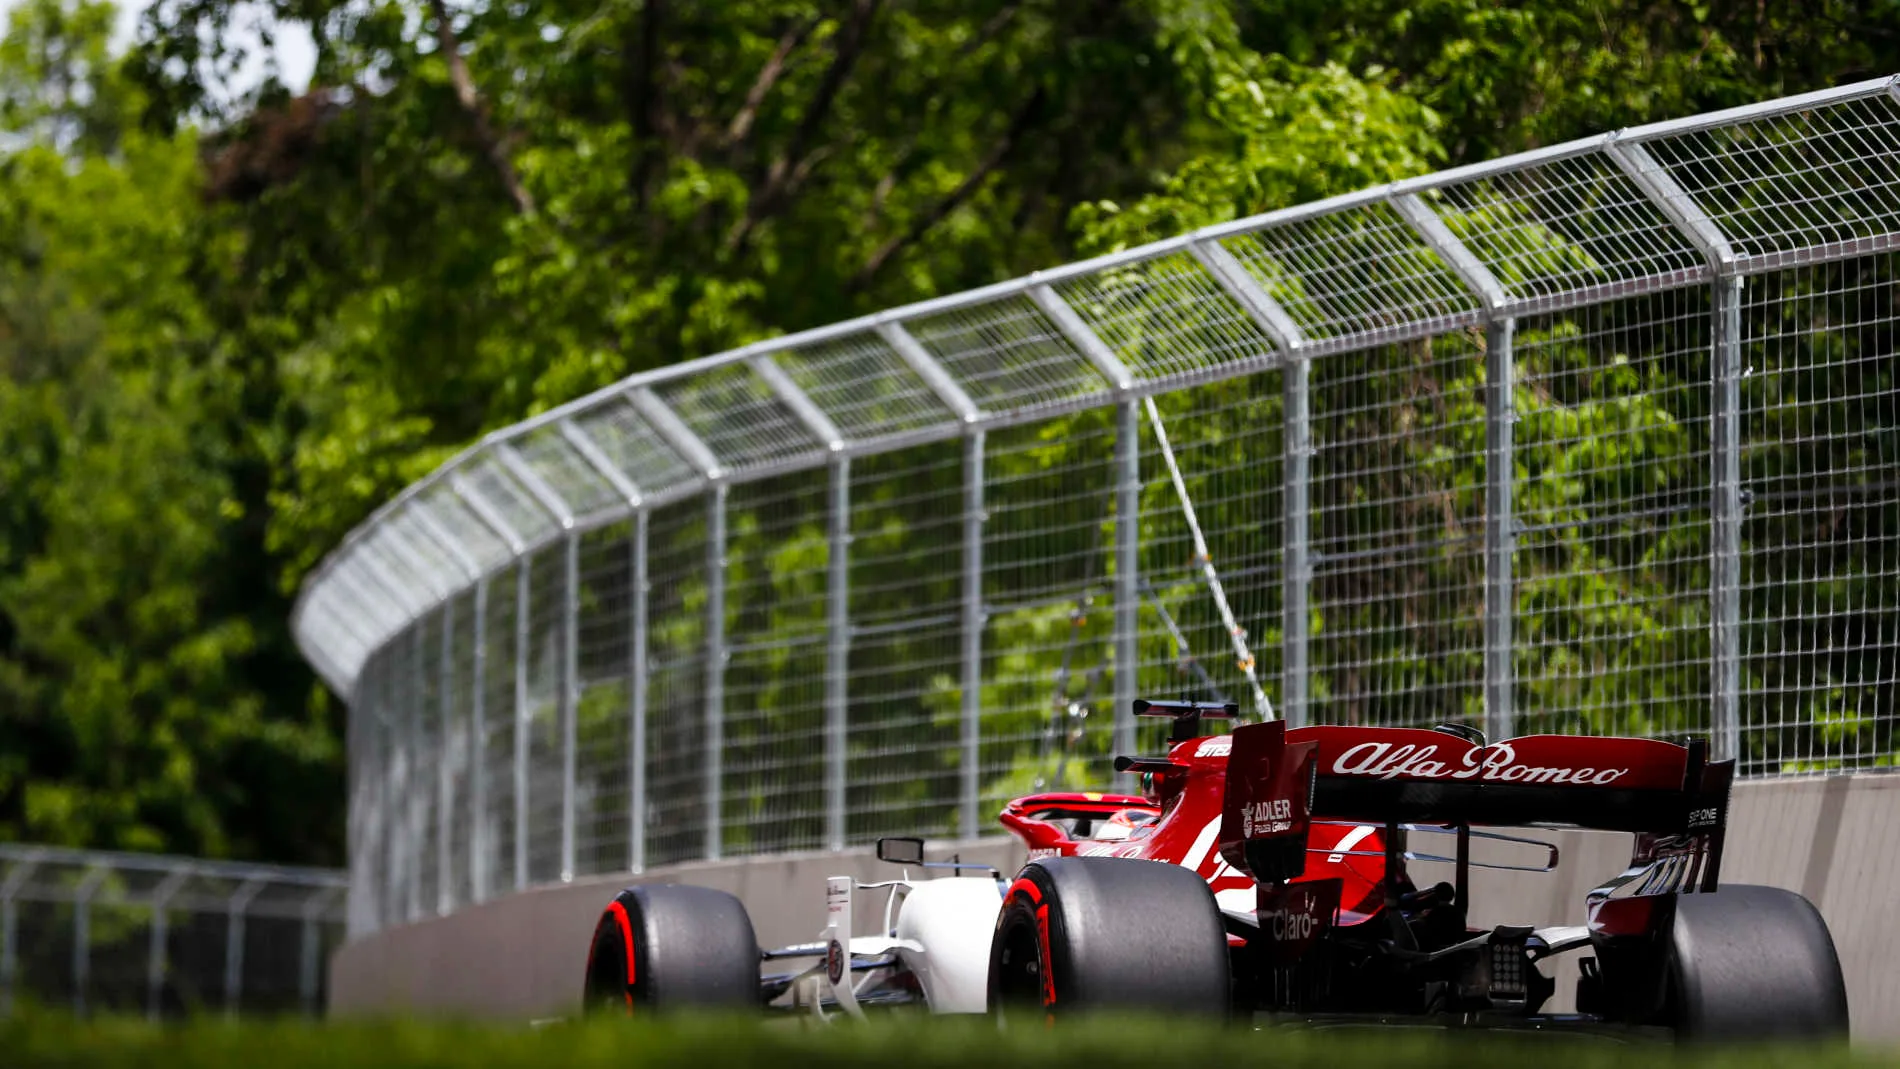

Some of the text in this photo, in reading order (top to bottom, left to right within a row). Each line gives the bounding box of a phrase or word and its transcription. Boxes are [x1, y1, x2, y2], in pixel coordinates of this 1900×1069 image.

[1332, 742, 1628, 785] Alfa Romeo
[1255, 799, 1291, 822] ADLER
